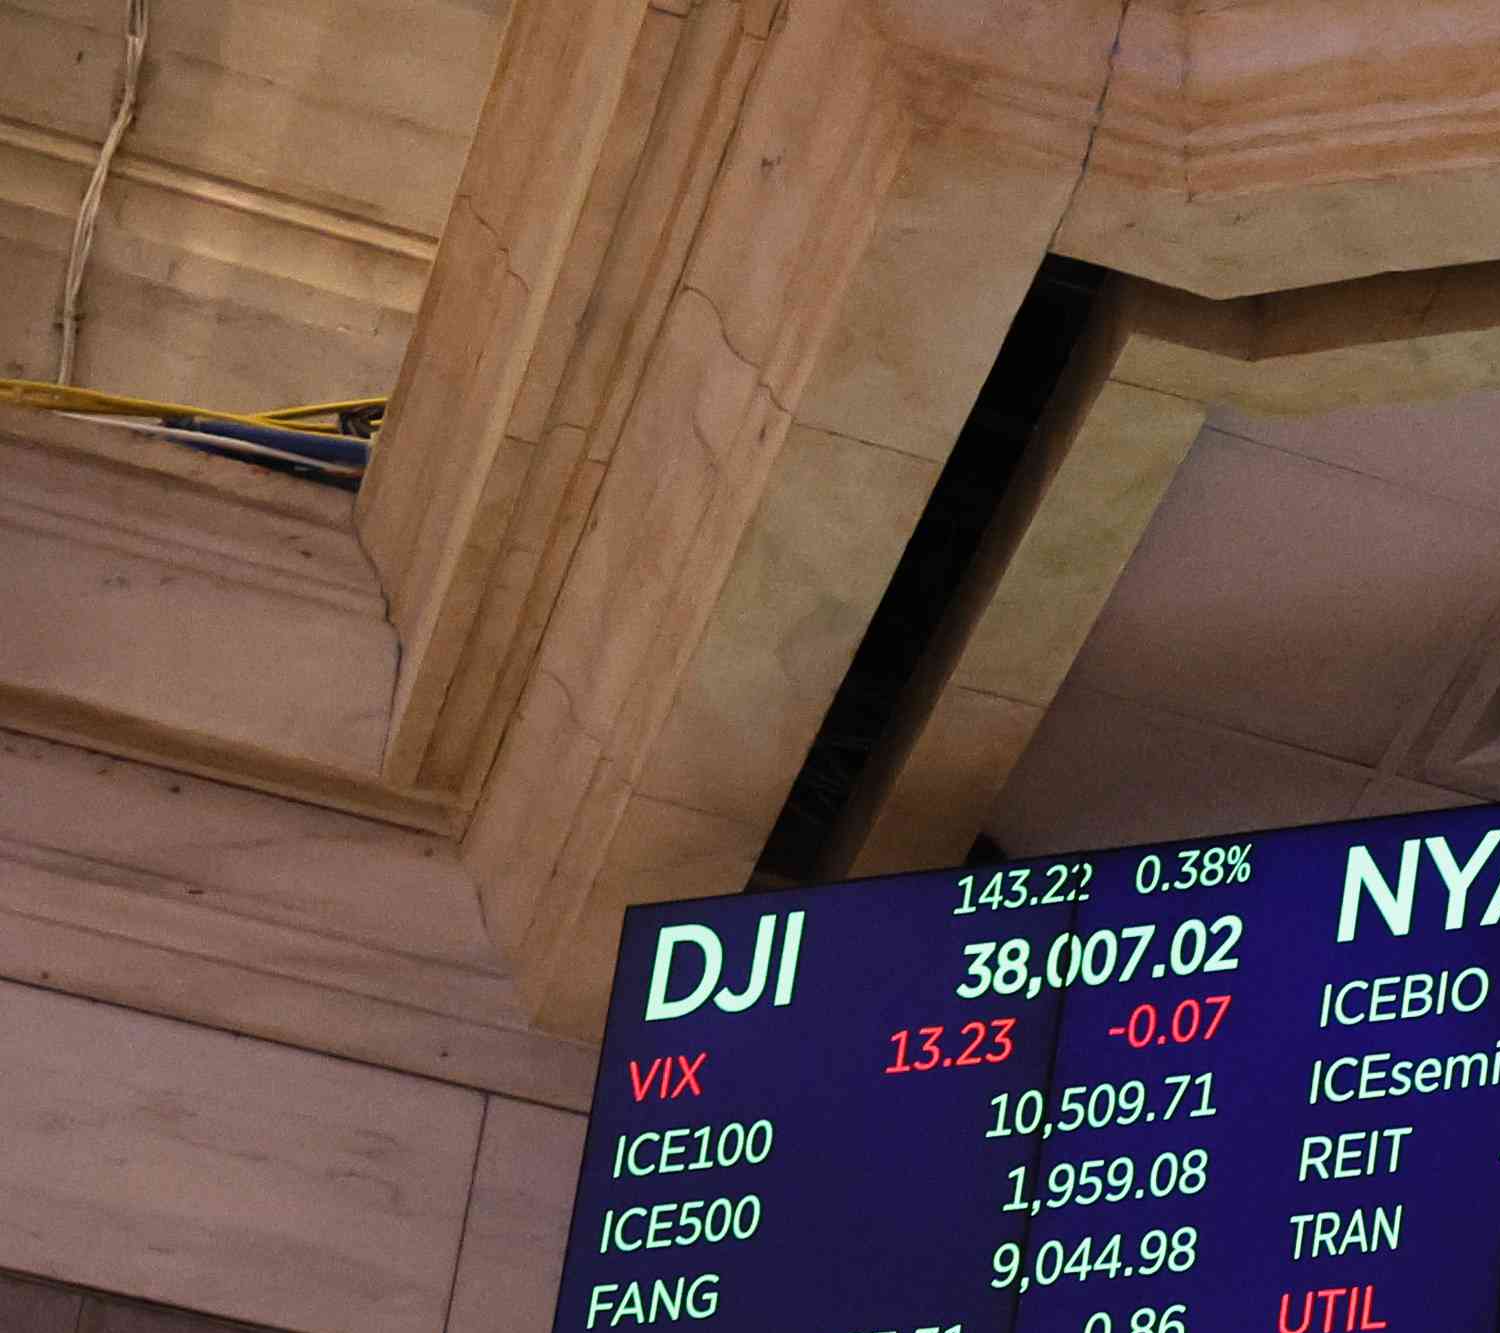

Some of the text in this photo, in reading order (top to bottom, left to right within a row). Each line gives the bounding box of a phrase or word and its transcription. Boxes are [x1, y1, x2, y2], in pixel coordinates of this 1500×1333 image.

[954, 844, 1251, 914] 143.22 0.38%
[645, 911, 805, 1021] DJI
[956, 915, 1242, 999] 38,007.02
[1320, 968, 1488, 1027] ICEBIO
[630, 995, 1232, 1101] VIX 13.23 -0.07
[613, 1073, 1216, 1178] ICE100 10,509.71
[1299, 1127, 1412, 1181] REIT
[600, 1149, 1208, 1253] ICE500 1,959.08
[1290, 1205, 1402, 1259] TRAN
[587, 1227, 1197, 1329] FANG 9,044.98
